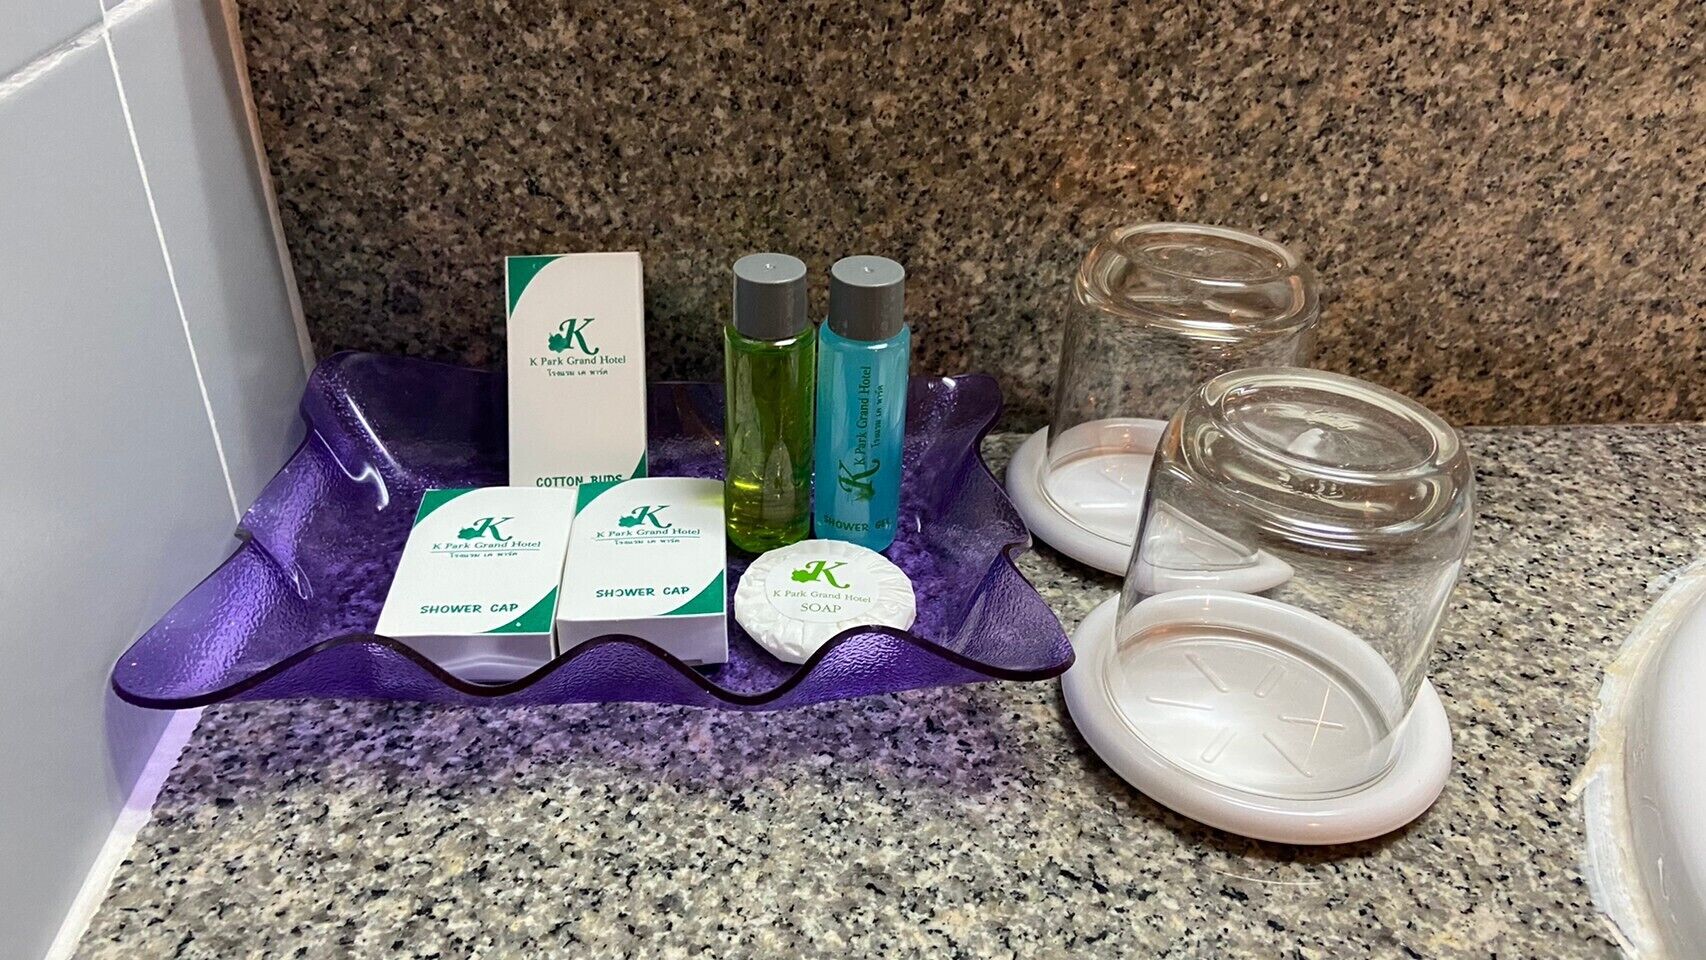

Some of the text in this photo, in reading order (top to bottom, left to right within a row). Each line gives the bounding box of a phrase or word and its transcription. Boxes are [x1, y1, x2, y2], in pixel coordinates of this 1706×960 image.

[529, 355, 626, 366] K Park Grand Hotel
[853, 366, 872, 466] K Park Grand Hotel
[536, 476, 584, 488] COTTON
[824, 513, 869, 532] SHOWER
[608, 528, 632, 537] Park
[636, 528, 669, 536] Grand
[474, 541, 508, 549] Grand
[596, 586, 690, 598] SHOWER CAP
[810, 591, 841, 599] Grand
[845, 595, 871, 603] Hotel
[420, 603, 518, 614] SHOWER CAP
[800, 602, 842, 613] SOAP
